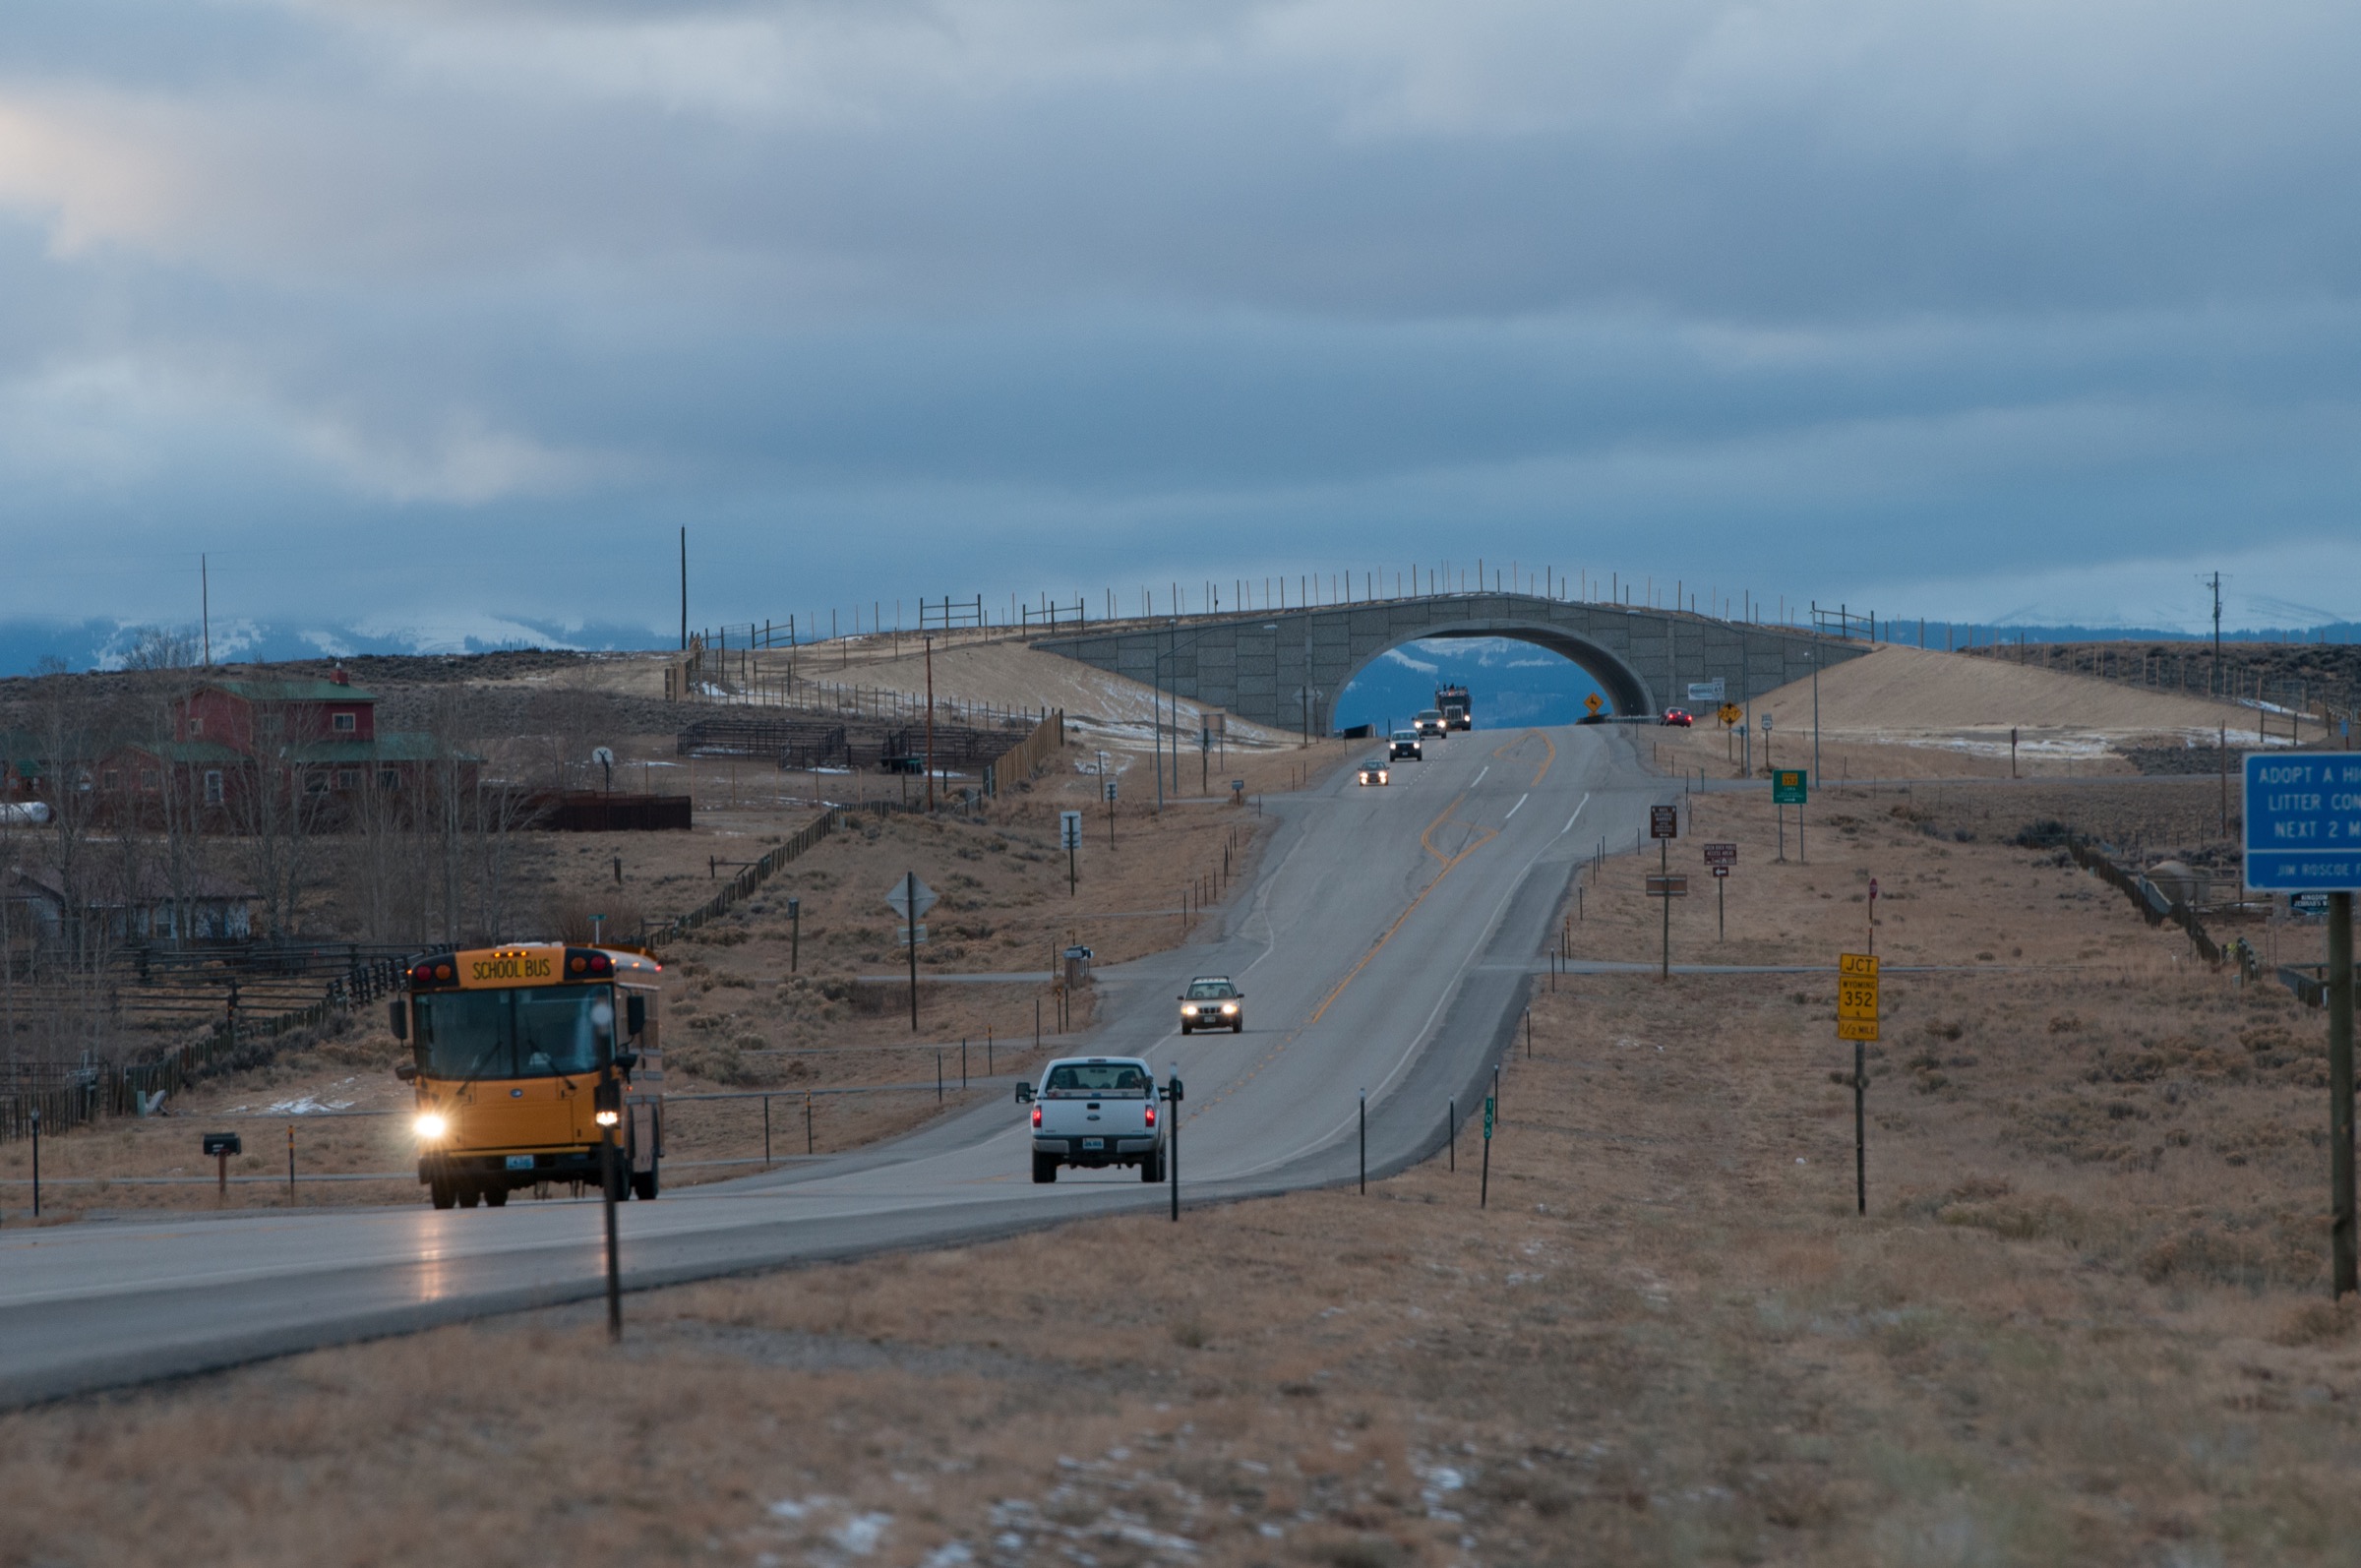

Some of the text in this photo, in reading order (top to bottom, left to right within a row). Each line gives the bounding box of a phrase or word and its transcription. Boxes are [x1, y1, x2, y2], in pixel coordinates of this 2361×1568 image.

[2259, 766, 2312, 783] ADOPT
[2323, 766, 2333, 783] A
[2269, 794, 2322, 811] LITTER
[2274, 820, 2317, 838] NEXT
[2328, 820, 2339, 838] 2
[473, 958, 551, 980] SCHOOL BUS
[1846, 958, 1873, 973] JCT
[1843, 980, 1876, 990] WYOMING
[1845, 991, 1873, 1007] 352
[1842, 1023, 1875, 1036] 1/2 MILE
